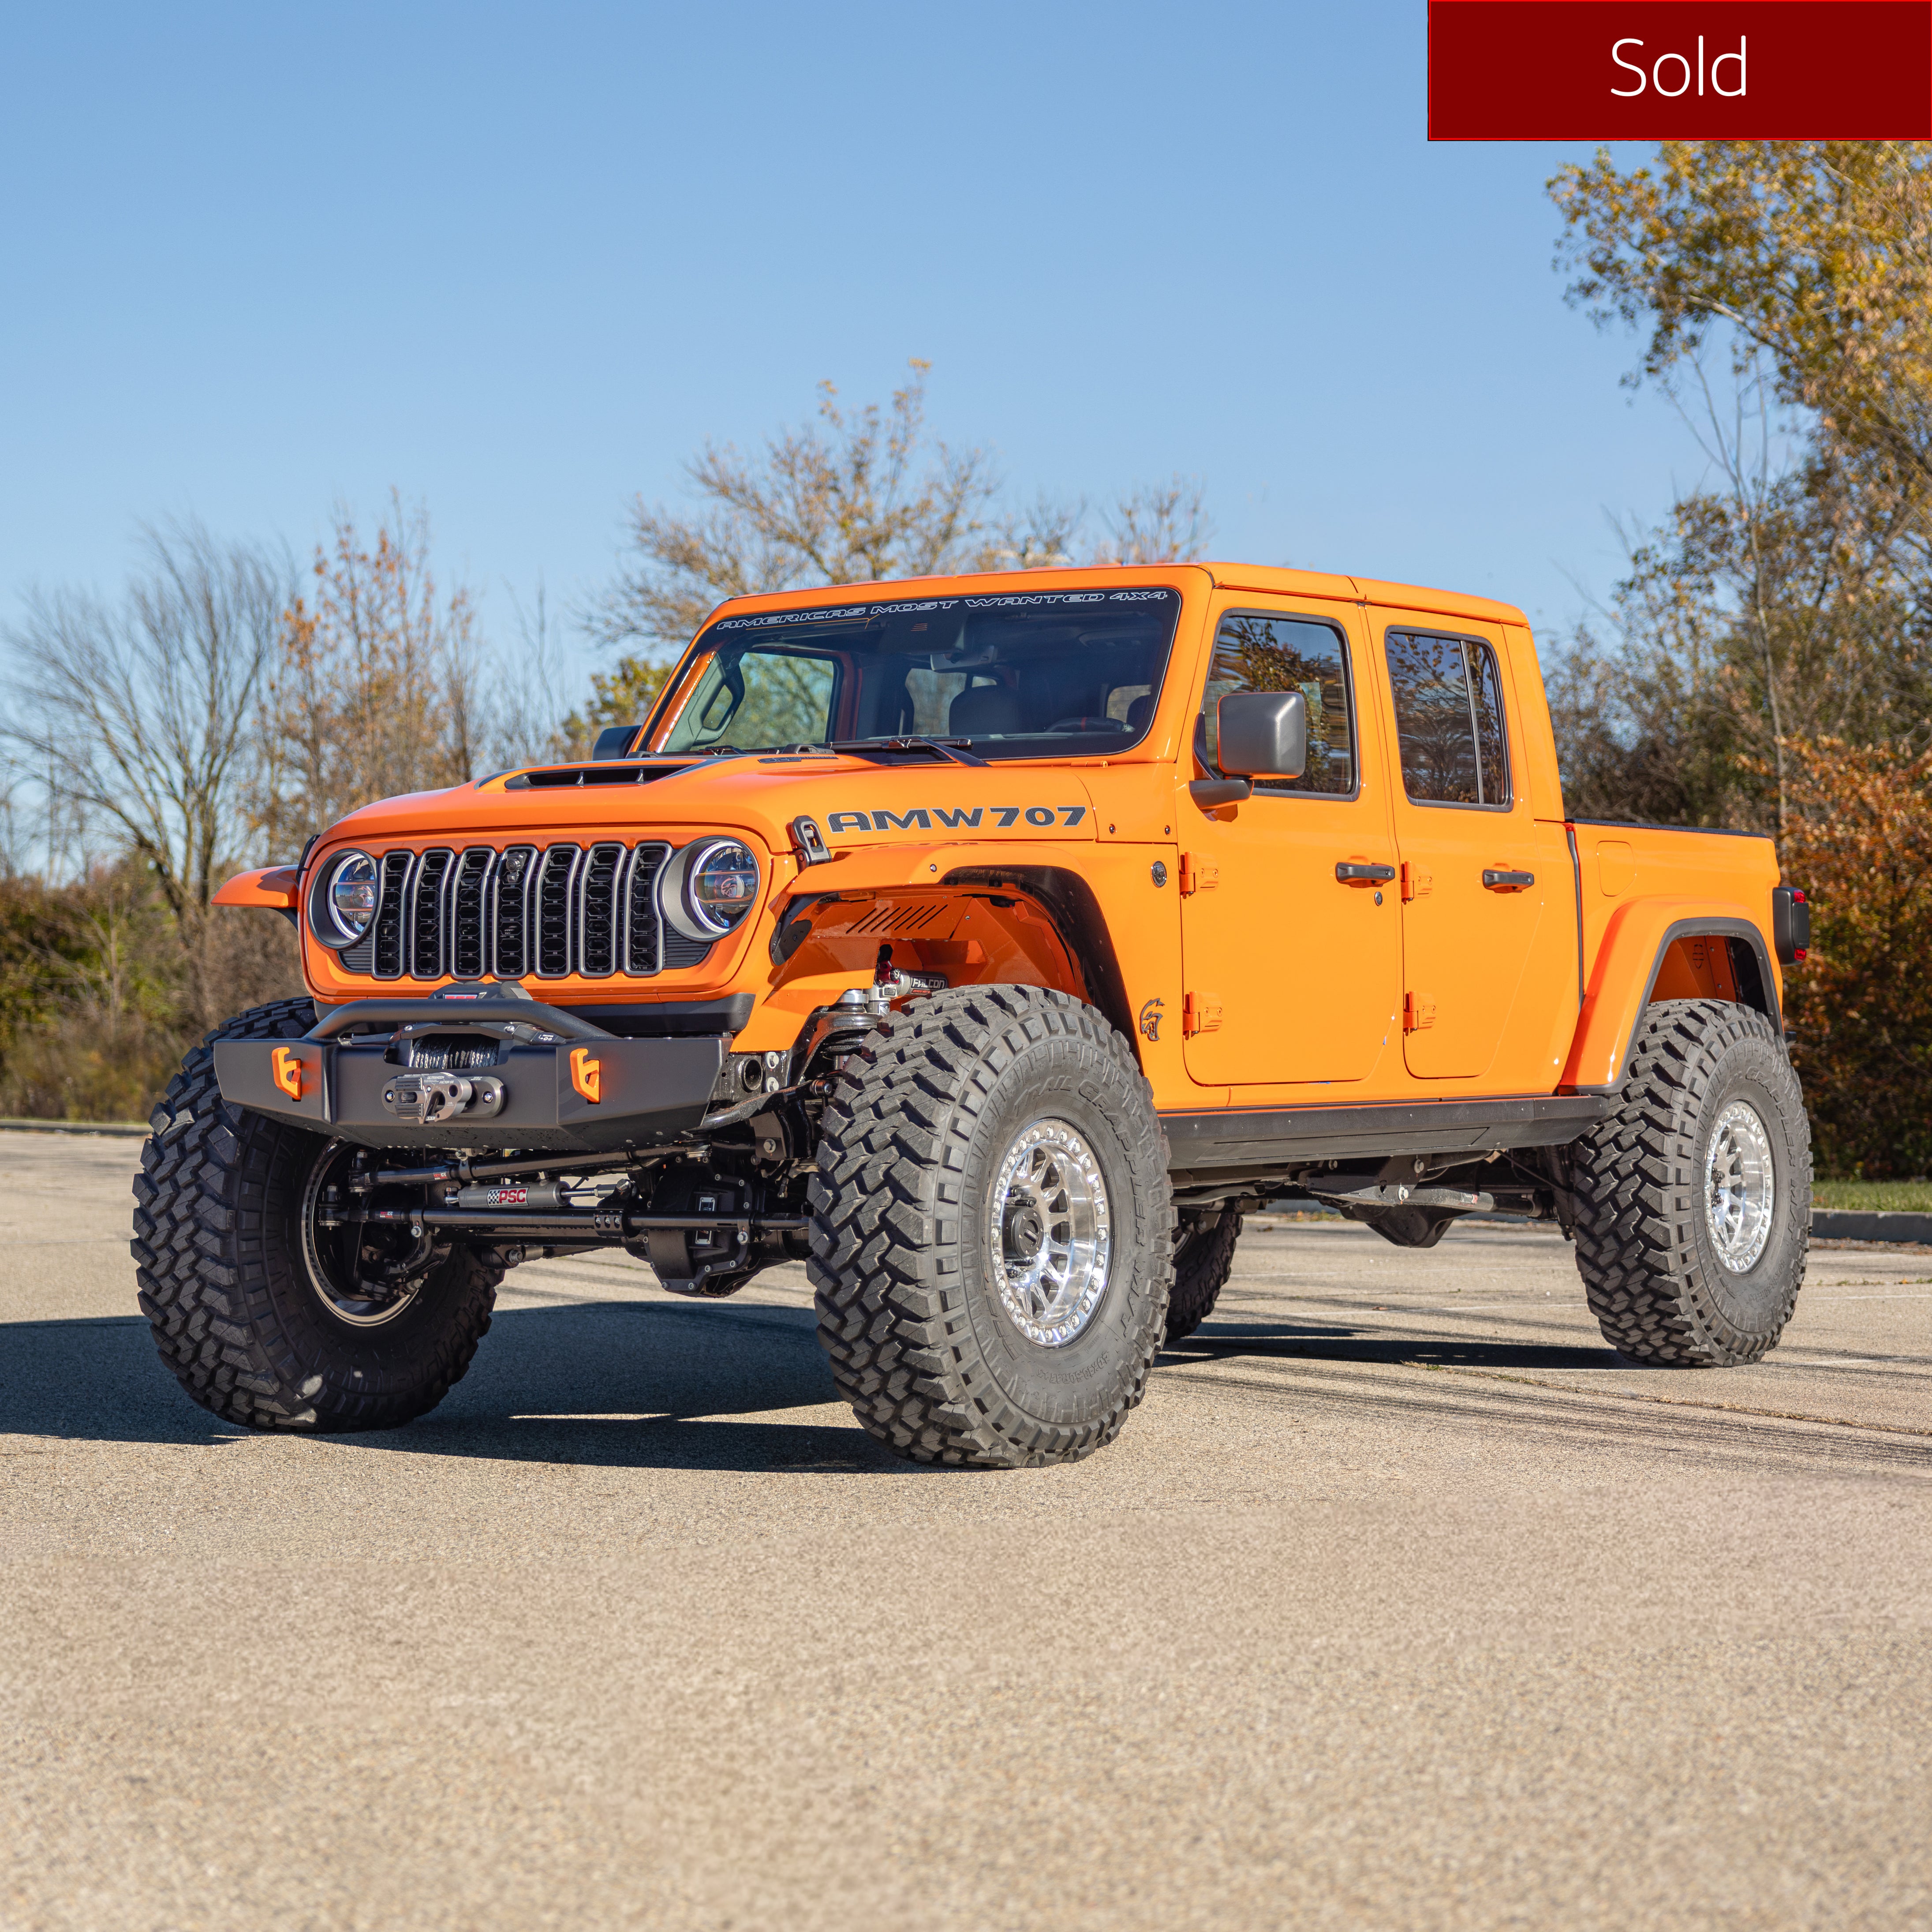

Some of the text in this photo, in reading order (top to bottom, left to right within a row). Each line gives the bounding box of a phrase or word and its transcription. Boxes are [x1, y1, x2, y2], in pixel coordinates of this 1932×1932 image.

[717, 607, 867, 630] AMERICAS
[870, 601, 959, 614] MOST
[964, 594, 1105, 607] WANTED
[826, 806, 1087, 833] AMW707
[912, 978, 945, 989] FALCON
[1078, 1079, 1146, 1247] GRAPPLER
[499, 1189, 527, 1204] PSC
